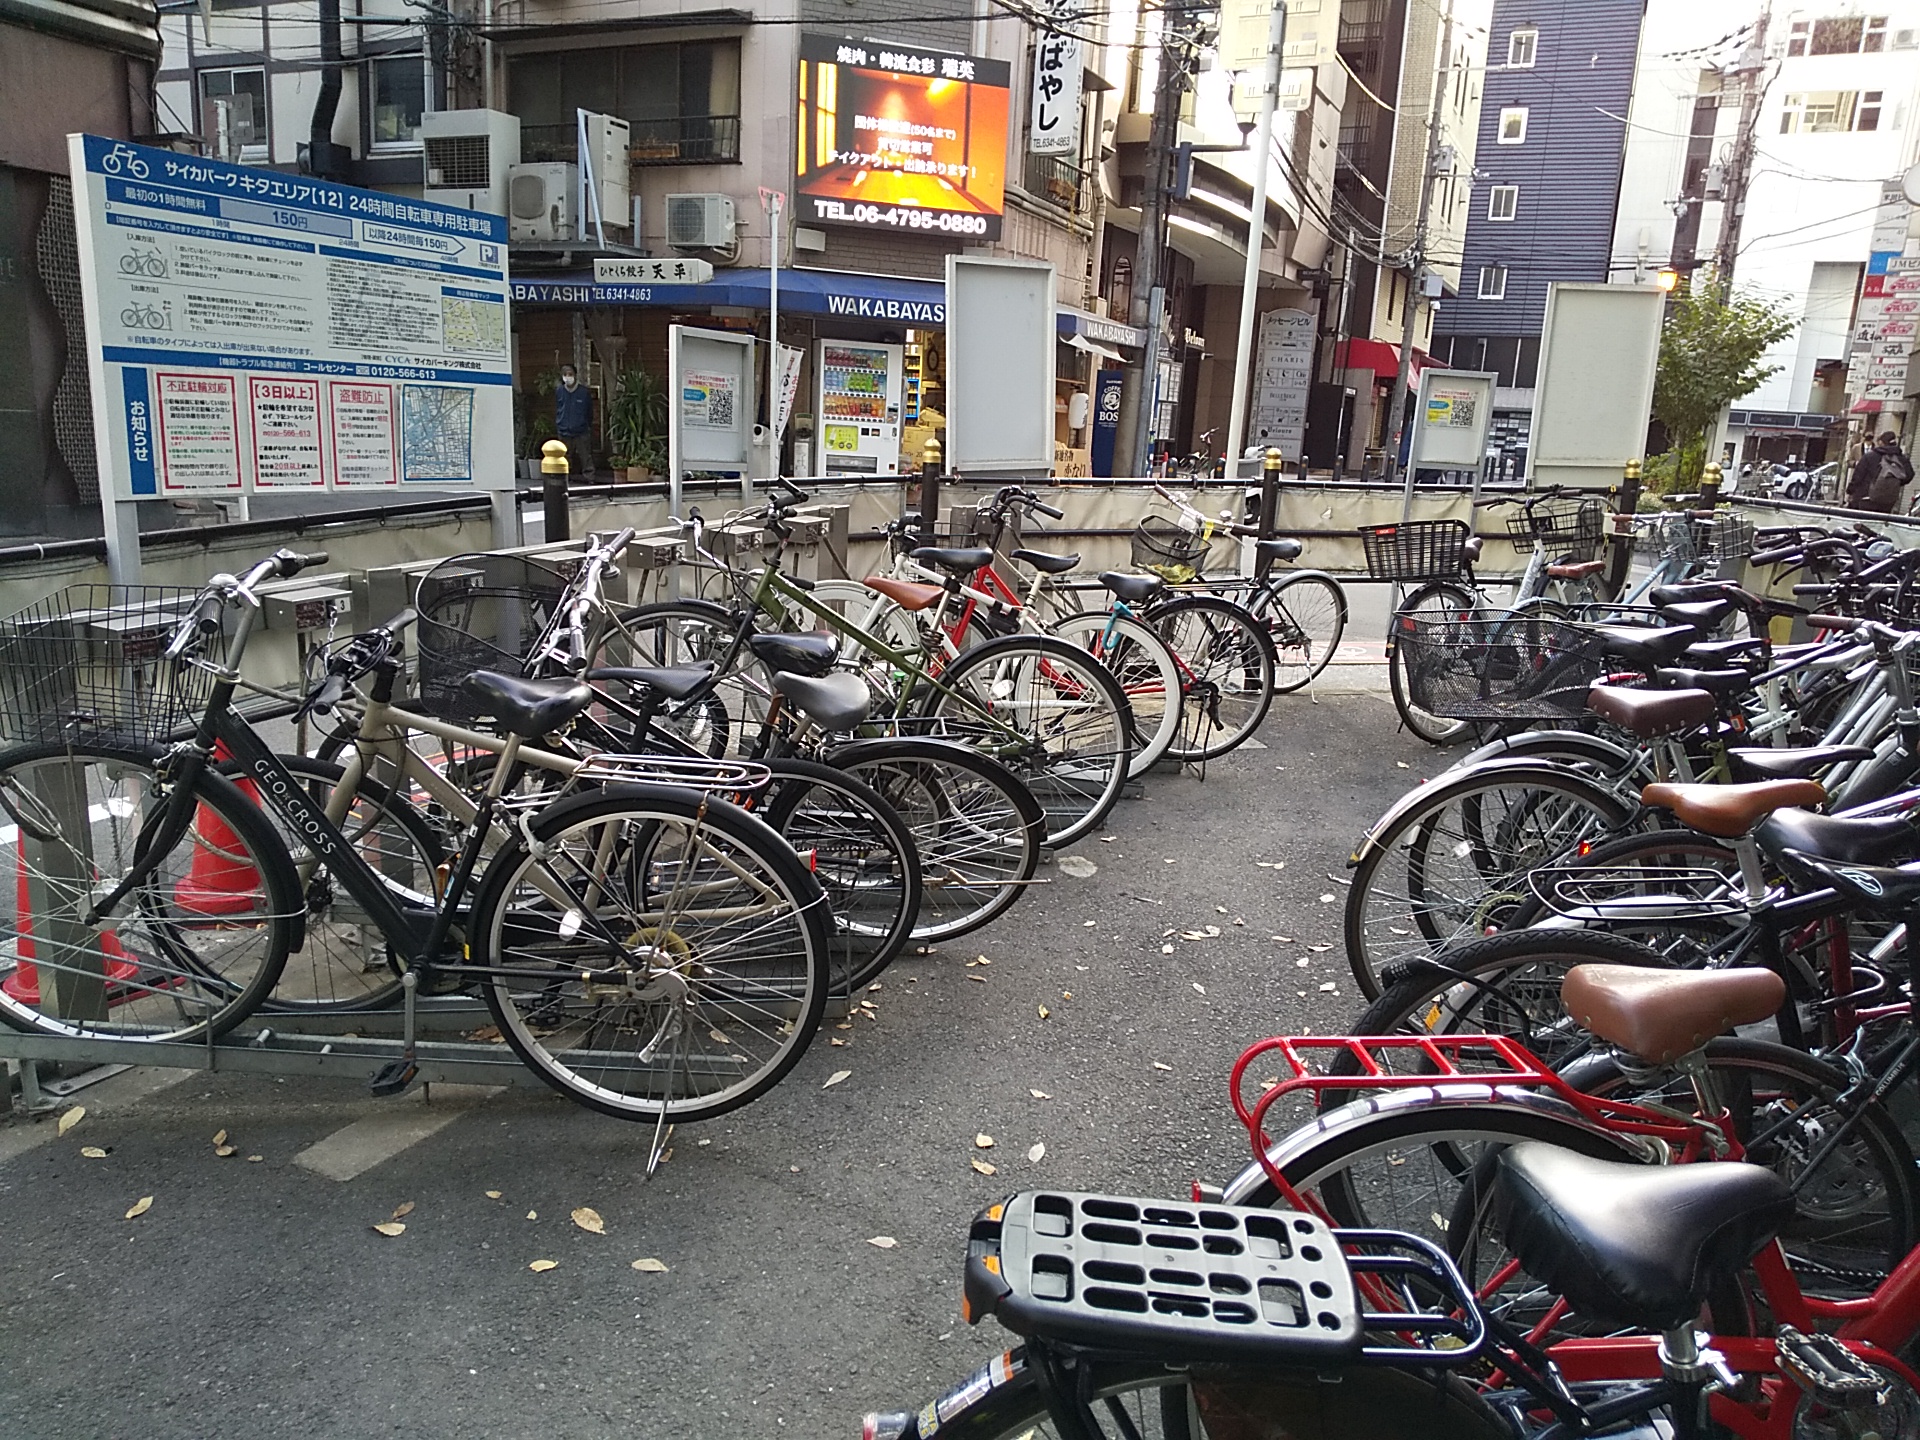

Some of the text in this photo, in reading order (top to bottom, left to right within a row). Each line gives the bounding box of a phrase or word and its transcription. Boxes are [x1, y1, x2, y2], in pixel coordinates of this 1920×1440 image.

[125, 186, 308, 228] 最初の1時間無料 150円
[165, 161, 491, 236] サイカパーク キタエリア【12】 24時間自転車専用駐車場
[814, 199, 987, 235] TEL.06-4795-0880
[369, 227, 448, 251] 以降24時間毎150円
[600, 265, 646, 278] ひとくち餃子
[652, 262, 687, 280] 天平
[1266, 316, 1311, 327] メッセージビル
[1087, 321, 1137, 346] WAKABAYASHI
[303, 362, 354, 373] コールセンター
[371, 366, 437, 380] 0120-566-613
[385, 354, 411, 364] CYCA
[414, 357, 482, 370] サイカパーキング株式会社
[166, 380, 228, 394] 不正駐輪対応
[255, 384, 314, 401] 【3日以上】
[339, 388, 385, 404] 盗難防止
[130, 401, 149, 462] お知らせ
[340, 600, 346, 611] 3
